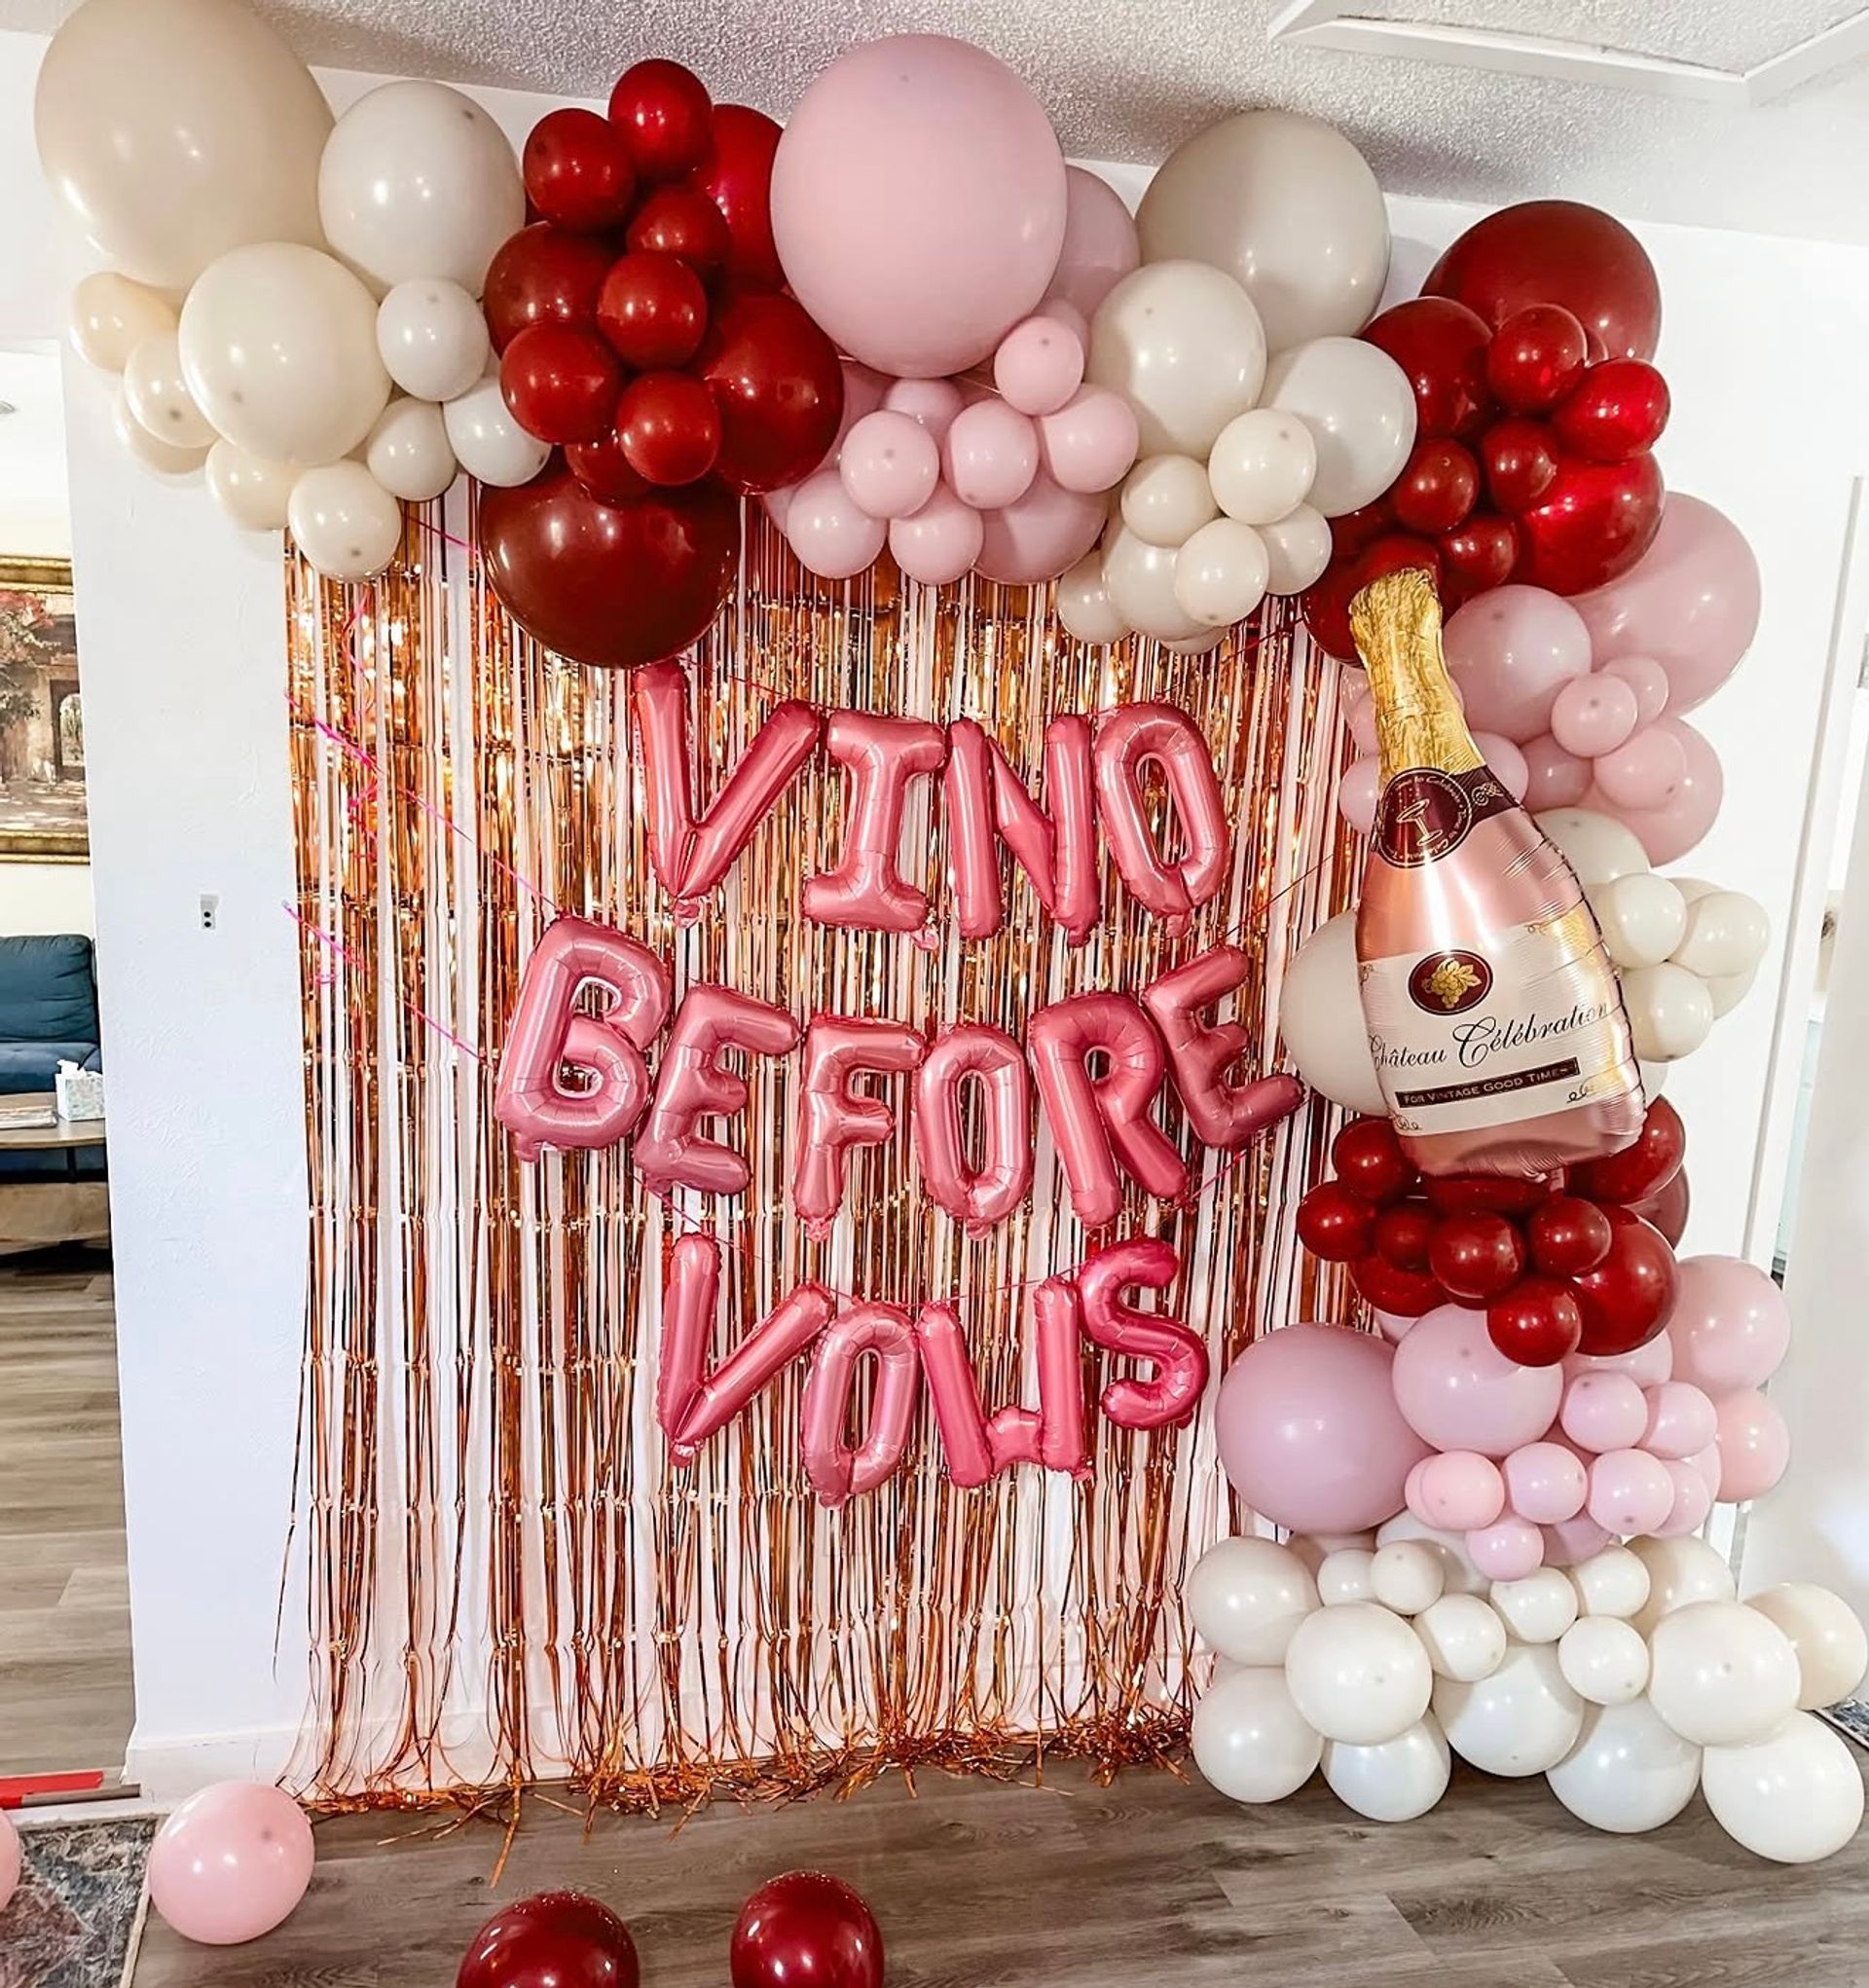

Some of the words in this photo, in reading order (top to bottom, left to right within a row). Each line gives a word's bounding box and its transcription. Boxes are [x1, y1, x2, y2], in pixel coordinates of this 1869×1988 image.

[634, 662, 1231, 948] VINO
[495, 913, 1305, 1240] BEFORE
[1368, 1034, 1448, 1071] Château
[1452, 1003, 1607, 1068] Célébration
[1426, 1086, 1481, 1101] VINTAGE
[1483, 1077, 1523, 1092] GOOD
[656, 1232, 1209, 1509] VOWS
